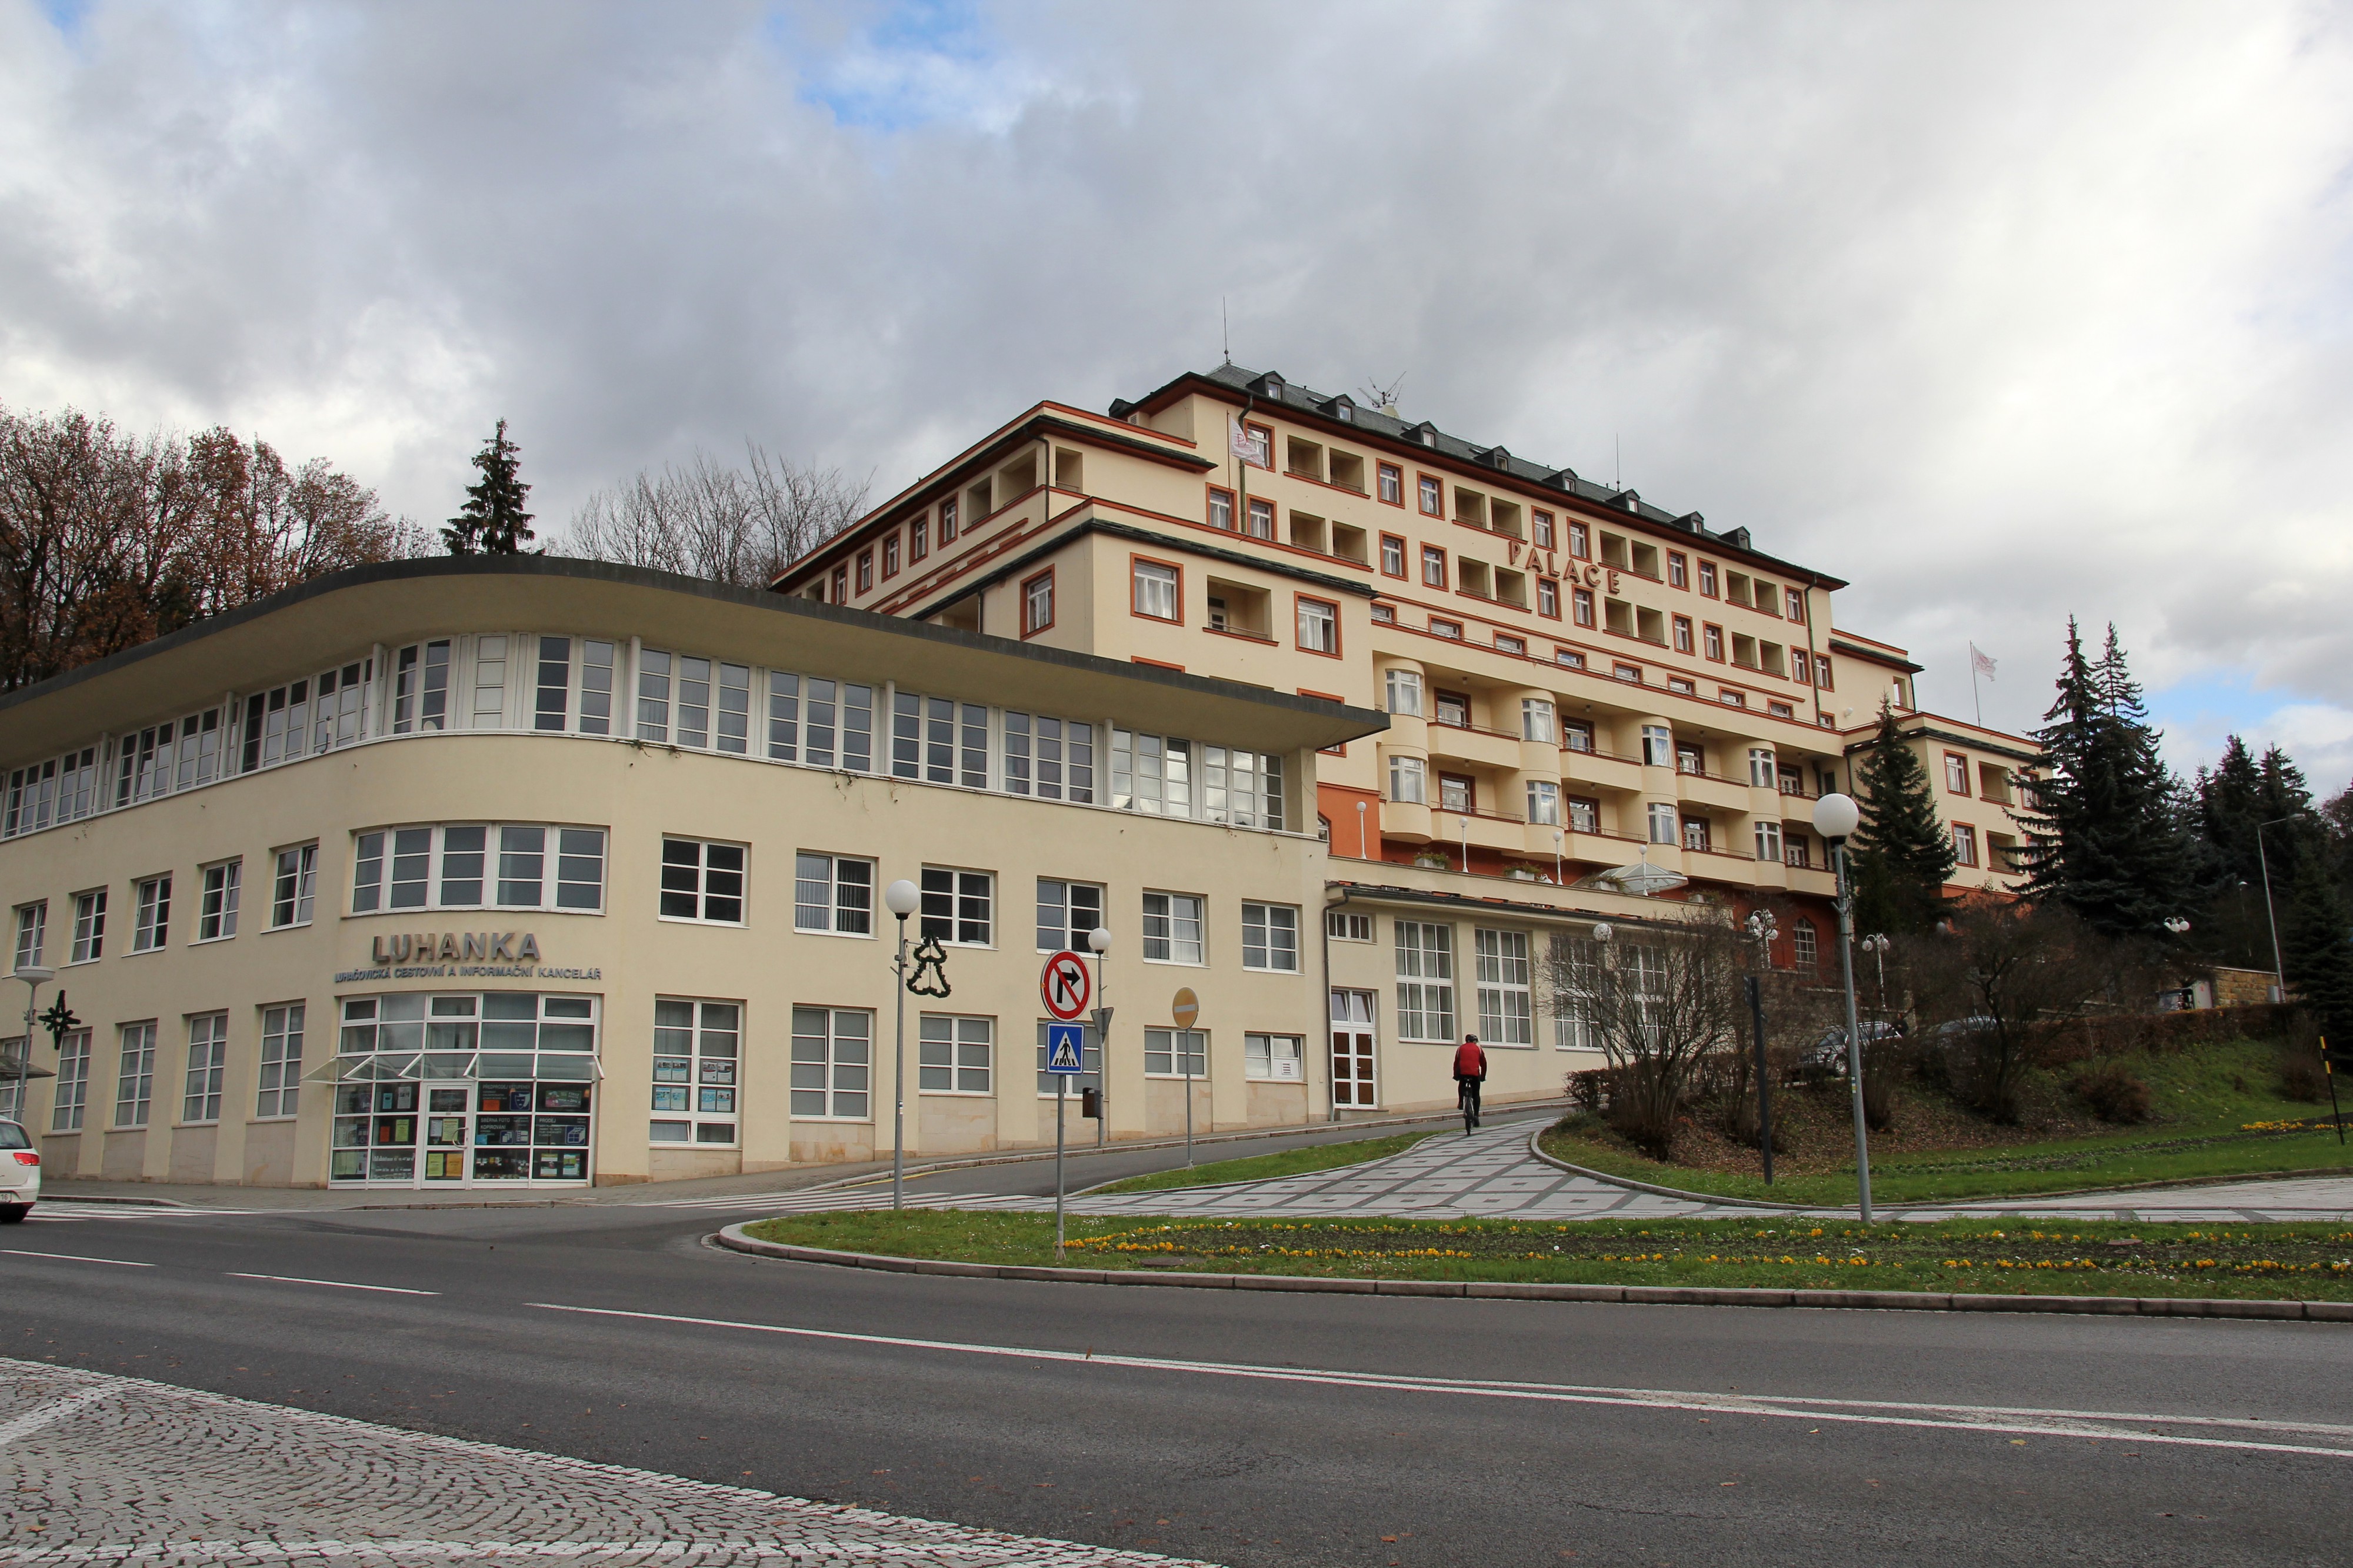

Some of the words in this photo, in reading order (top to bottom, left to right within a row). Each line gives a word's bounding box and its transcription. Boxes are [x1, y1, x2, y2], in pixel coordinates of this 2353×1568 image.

[1508, 540, 1620, 594] PALACE
[372, 932, 541, 962] LUHANKA
[334, 968, 391, 983] LUHAČOVICKÁ
[394, 965, 446, 978] CESTOVNÍ
[448, 966, 456, 976] A
[460, 965, 534, 977] INFORMAČNÍ
[538, 967, 602, 980] KANCELÁŘ
